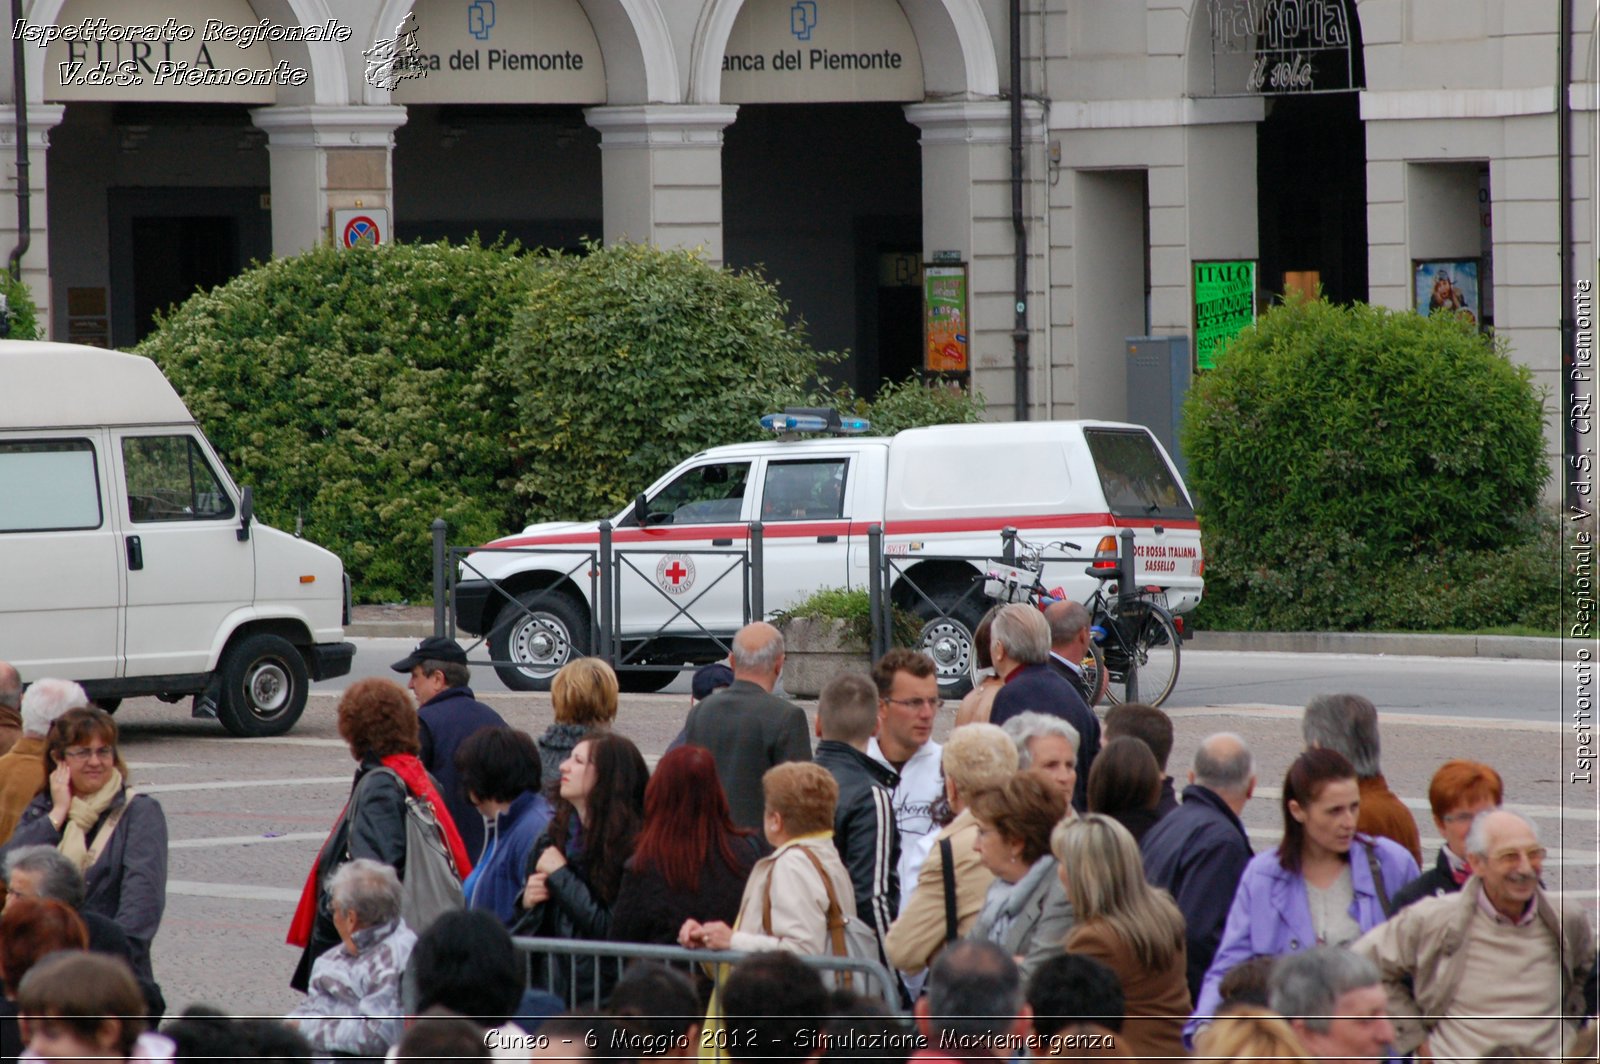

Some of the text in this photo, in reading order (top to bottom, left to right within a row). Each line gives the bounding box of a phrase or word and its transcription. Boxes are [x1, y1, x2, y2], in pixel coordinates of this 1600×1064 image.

[67, 40, 218, 75] FURLA
[393, 50, 583, 71] anca del Piemonte
[722, 49, 902, 71] anca del Piemonte
[1270, 55, 1313, 88] sole
[1146, 546, 1167, 558] ROSSA
[1168, 546, 1197, 559] ITALIANA
[1145, 560, 1175, 572] SASSELLO
